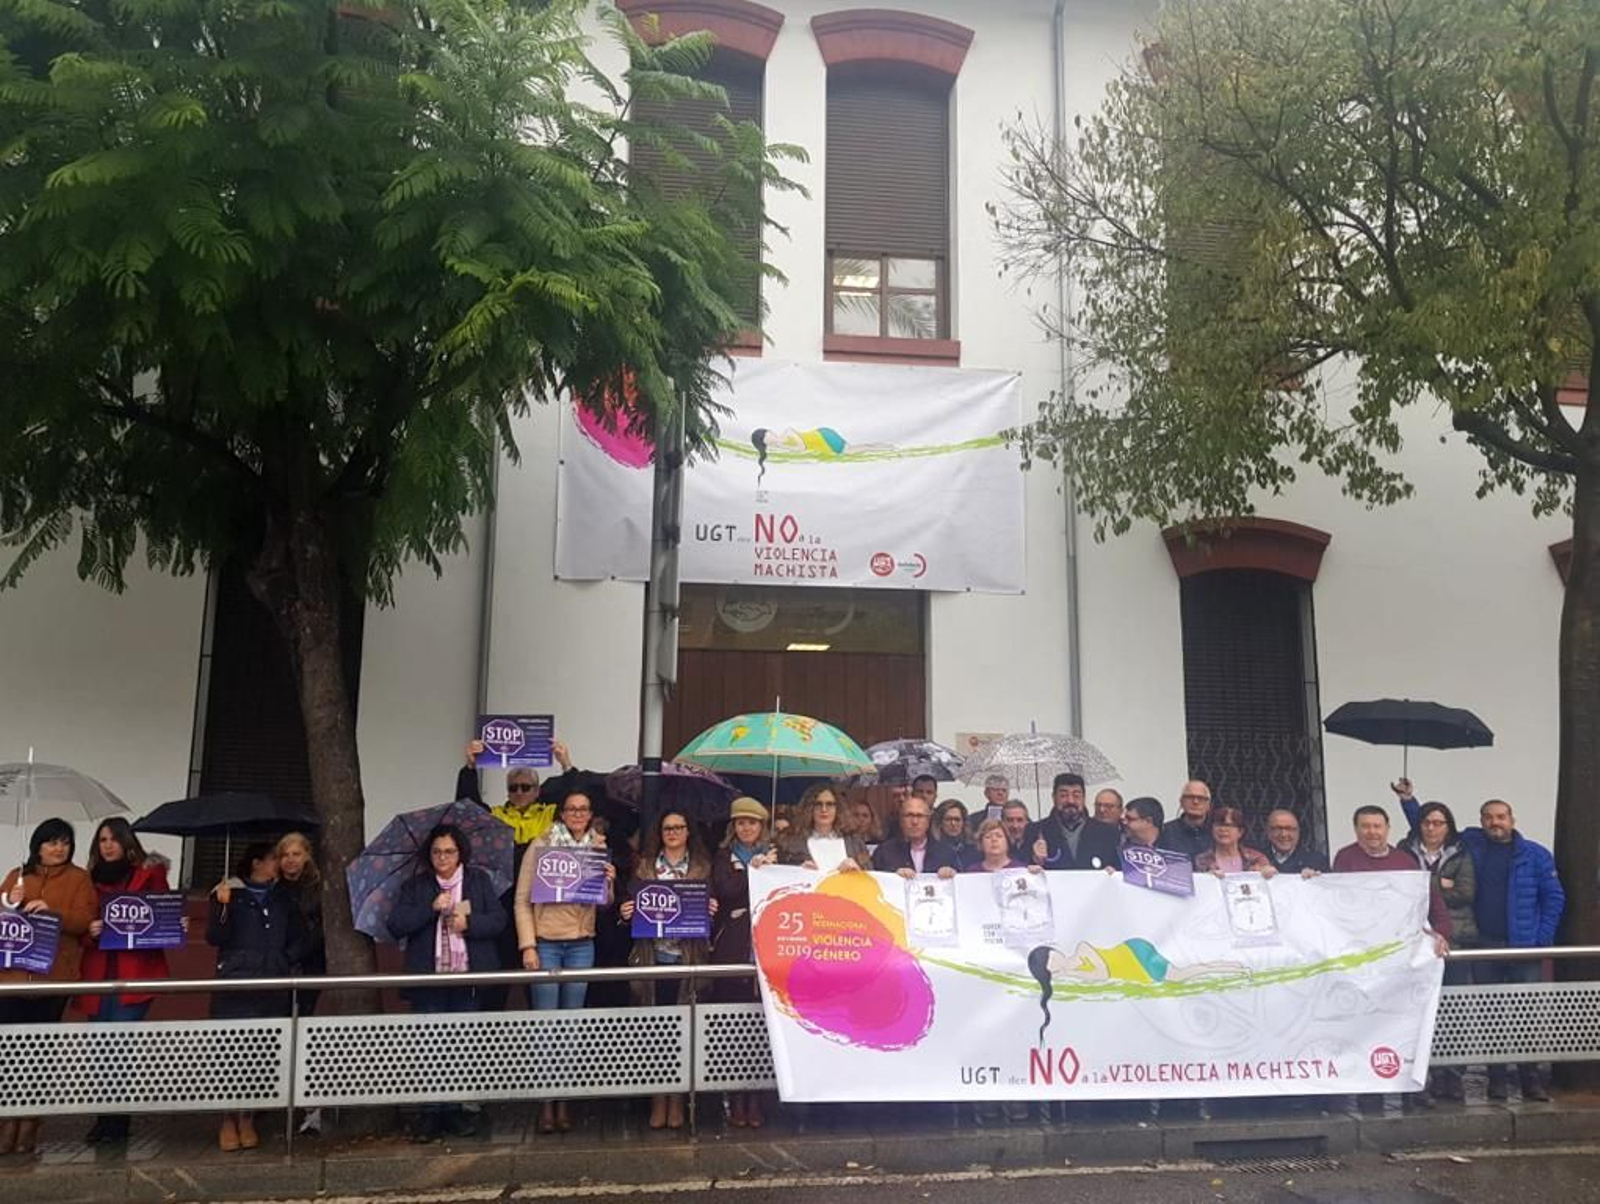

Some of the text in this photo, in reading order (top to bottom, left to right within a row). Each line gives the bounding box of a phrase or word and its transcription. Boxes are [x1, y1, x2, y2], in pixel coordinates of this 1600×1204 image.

[695, 524, 737, 542] UGT
[755, 513, 798, 544] NO
[809, 535, 821, 544] la
[754, 547, 837, 561] VIOLENCIA
[754, 563, 838, 578] MACHISTA
[486, 726, 521, 741] STOP
[541, 858, 577, 874] STOP
[1127, 850, 1164, 866] STOP
[641, 892, 677, 908] STOP
[110, 903, 149, 918] STOP
[0, 921, 30, 938] TOP
[777, 911, 804, 935] 25
[813, 934, 873, 948] VIOLENCIA
[777, 944, 812, 960] 2019
[812, 948, 861, 962] GÉNERO
[961, 1066, 1000, 1085] UGT
[1030, 1047, 1080, 1085] NO
[1093, 1072, 1108, 1083] la
[1109, 1063, 1219, 1082] VIOLENCIA
[1228, 1060, 1339, 1079] MACHISTA
